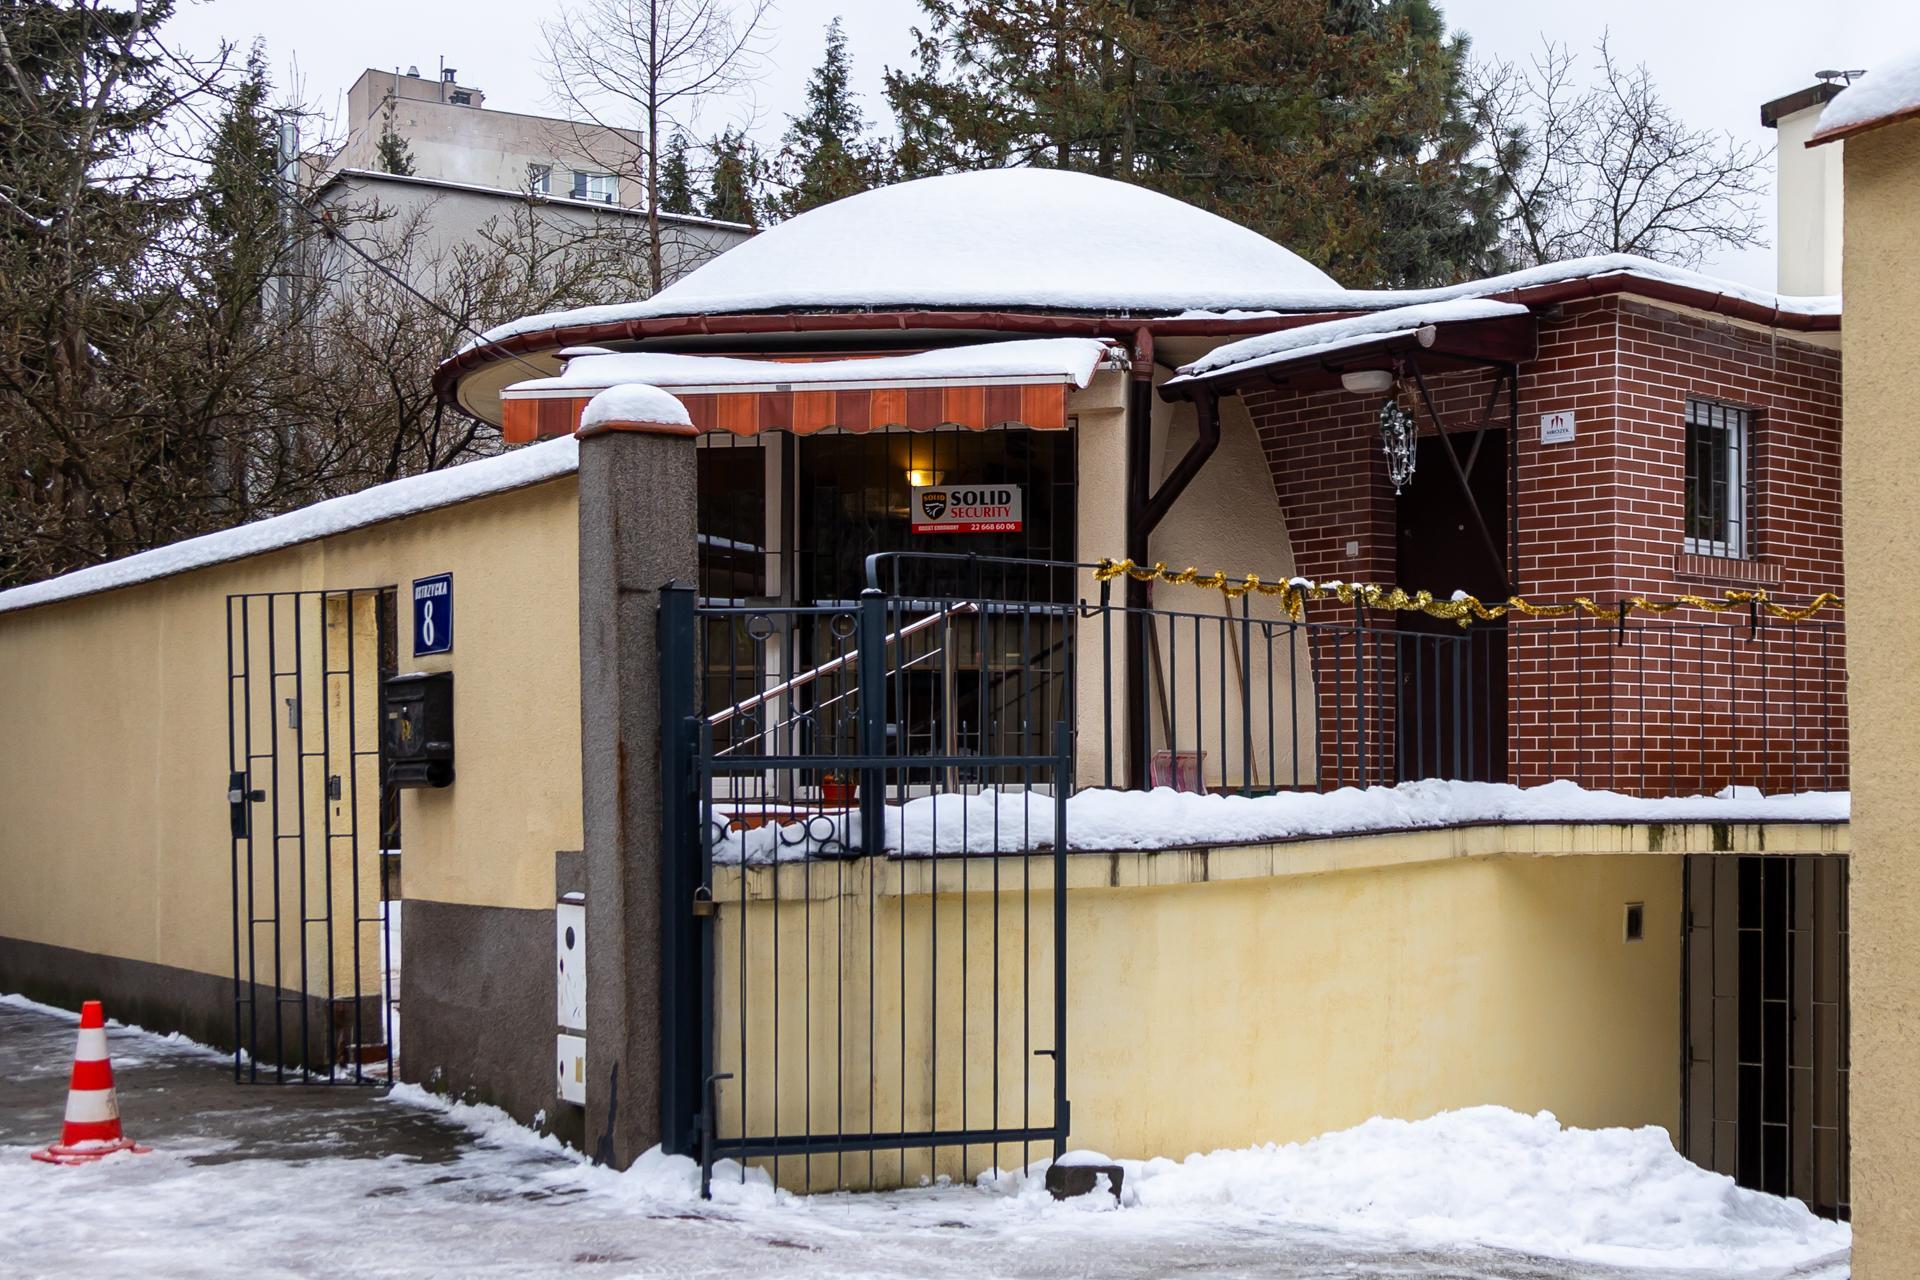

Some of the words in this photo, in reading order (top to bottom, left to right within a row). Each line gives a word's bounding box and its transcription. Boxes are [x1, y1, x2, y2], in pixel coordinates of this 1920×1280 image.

[950, 490, 1012, 506] SOLID
[950, 506, 1011, 518] SECURITY
[423, 600, 435, 646] 8
